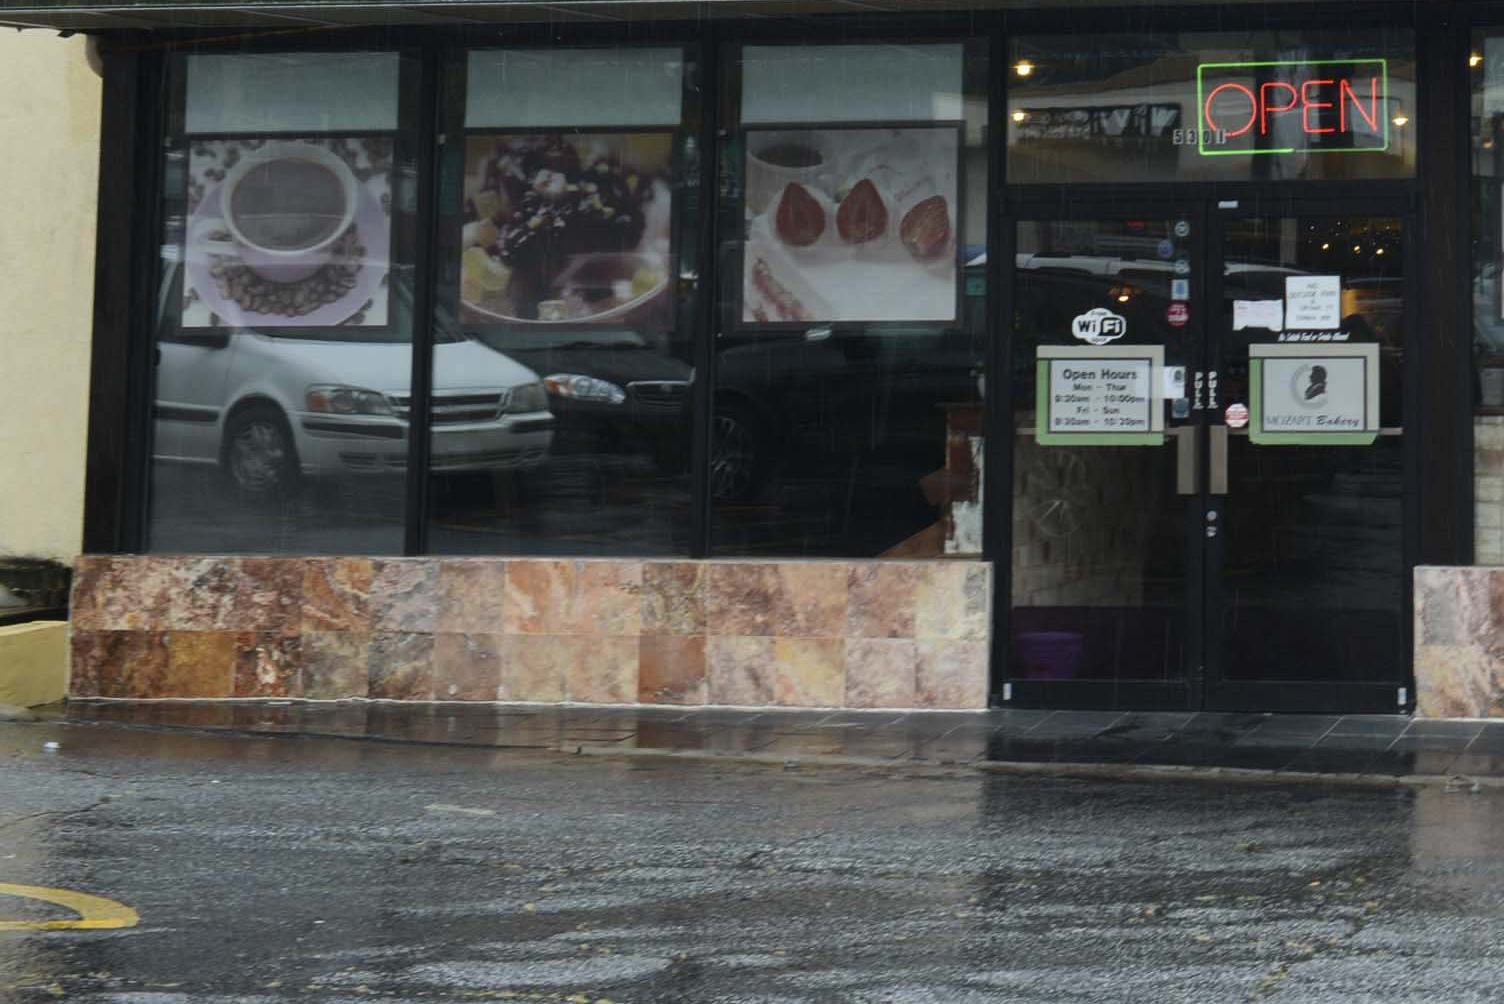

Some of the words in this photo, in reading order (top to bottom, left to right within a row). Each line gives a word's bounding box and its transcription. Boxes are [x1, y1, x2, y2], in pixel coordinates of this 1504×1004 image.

[1204, 77, 1379, 137] OPEN
[1172, 128, 1227, 145] 5301
[1062, 368, 1096, 381] Open
[1101, 368, 1138, 380] Hours
[1073, 383, 1093, 391] Mon
